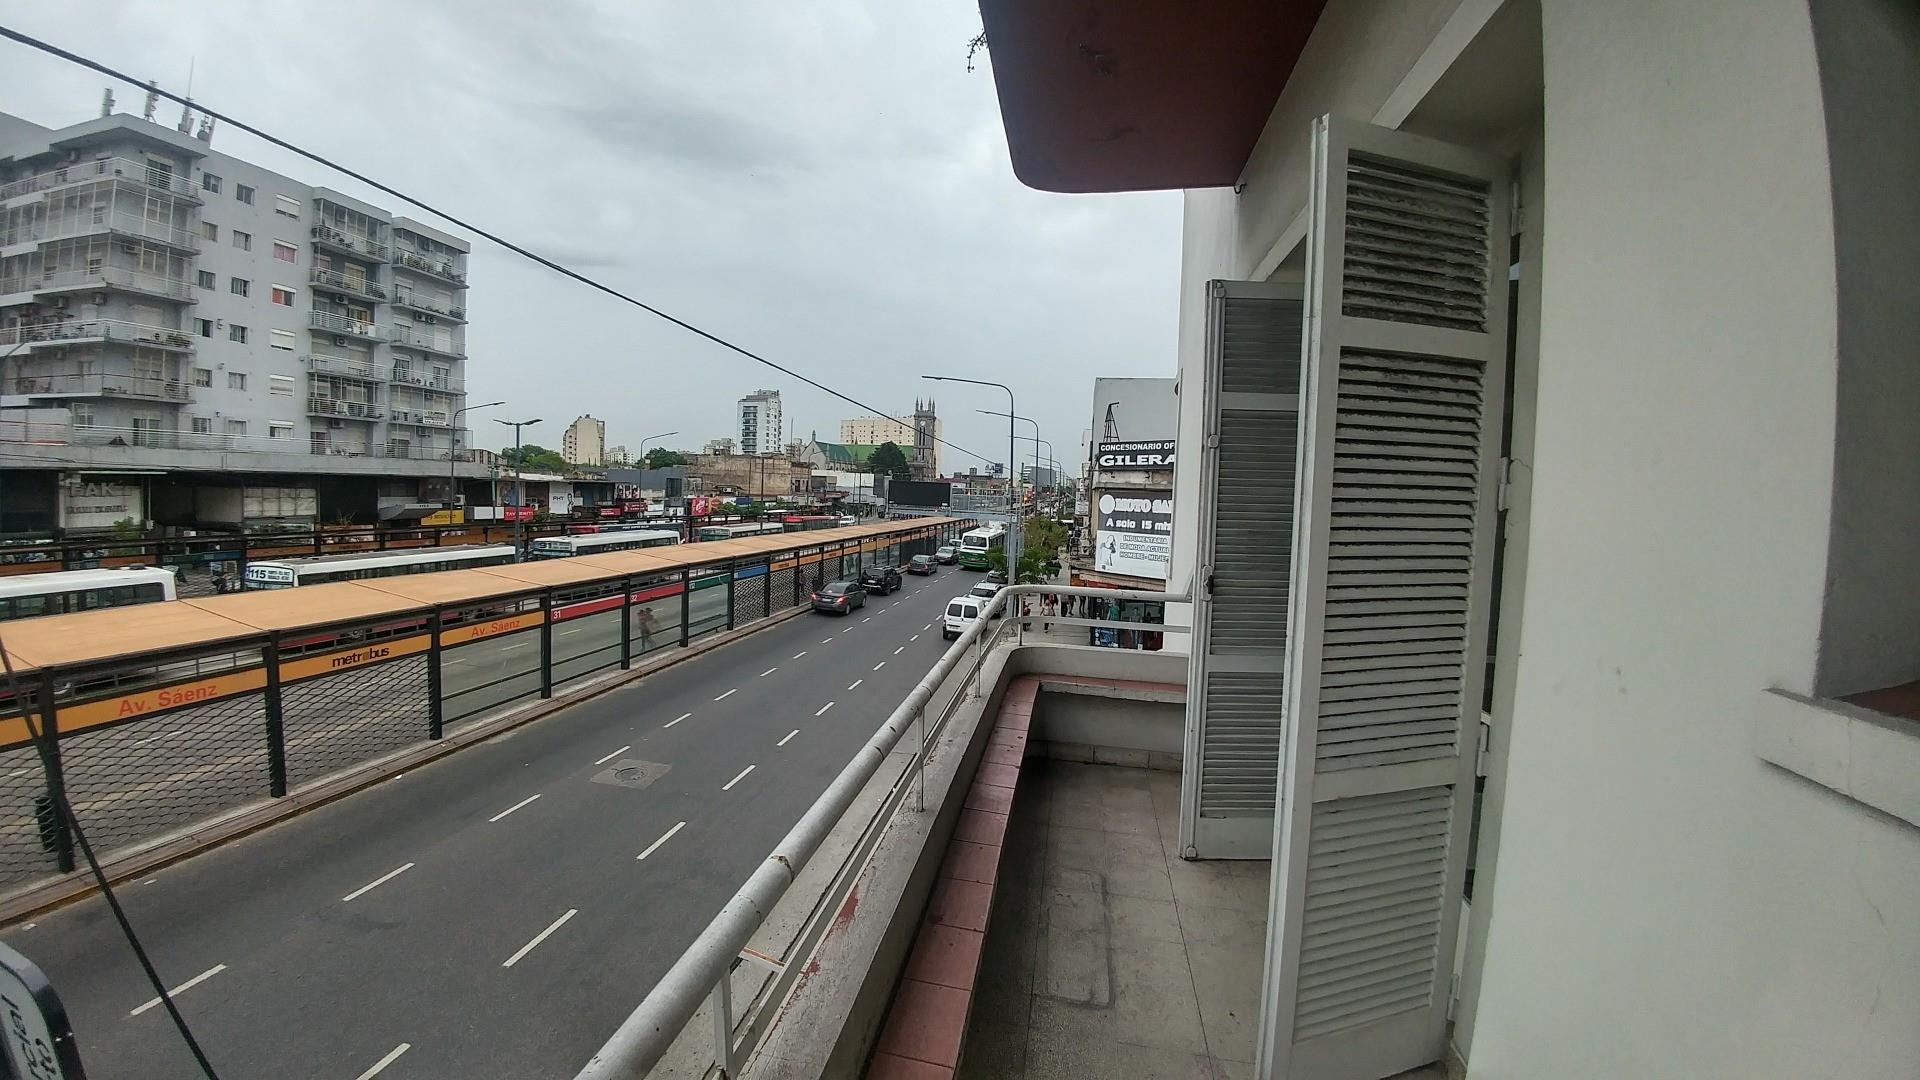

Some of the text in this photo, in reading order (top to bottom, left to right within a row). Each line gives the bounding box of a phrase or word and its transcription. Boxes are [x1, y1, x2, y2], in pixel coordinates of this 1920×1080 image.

[1100, 443, 1162, 452] CONCESIONARIO
[1099, 454, 1175, 467] GILERA
[1115, 498, 1152, 513] MOTO
[1106, 517, 1115, 527] A
[1115, 519, 1136, 529] solo
[1142, 520, 1153, 530] 15
[1123, 535, 1168, 545] INDUMENTARIA
[250, 568, 266, 579] 115
[553, 610, 561, 619] 31
[472, 627, 487, 638] Av.
[119, 685, 218, 716] Av. Sáenz
